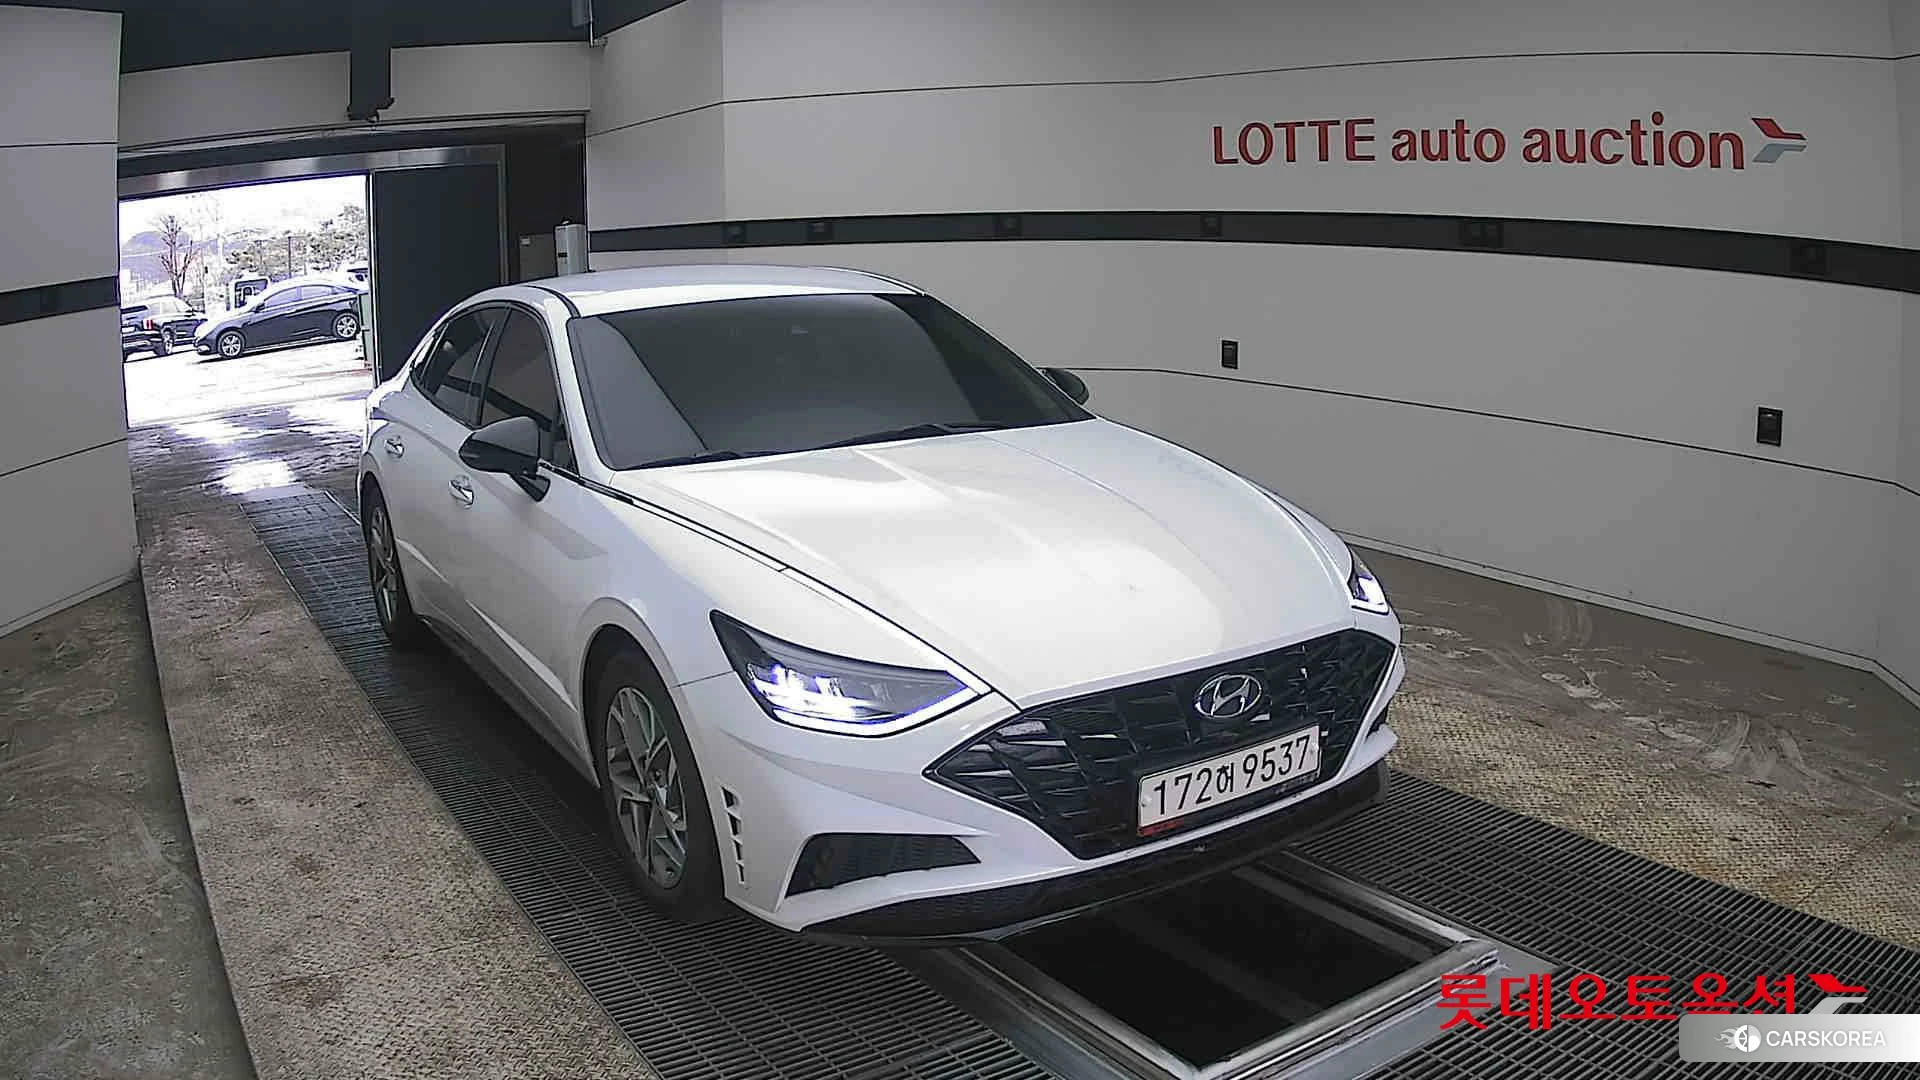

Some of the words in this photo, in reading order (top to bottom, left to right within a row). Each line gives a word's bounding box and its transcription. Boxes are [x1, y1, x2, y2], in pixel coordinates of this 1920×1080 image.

[1212, 118, 1376, 165] LOTTE
[1391, 118, 1507, 164] auto
[1522, 111, 1746, 171] auction
[1153, 762, 1234, 815] 172허
[1243, 734, 1310, 789] 9537
